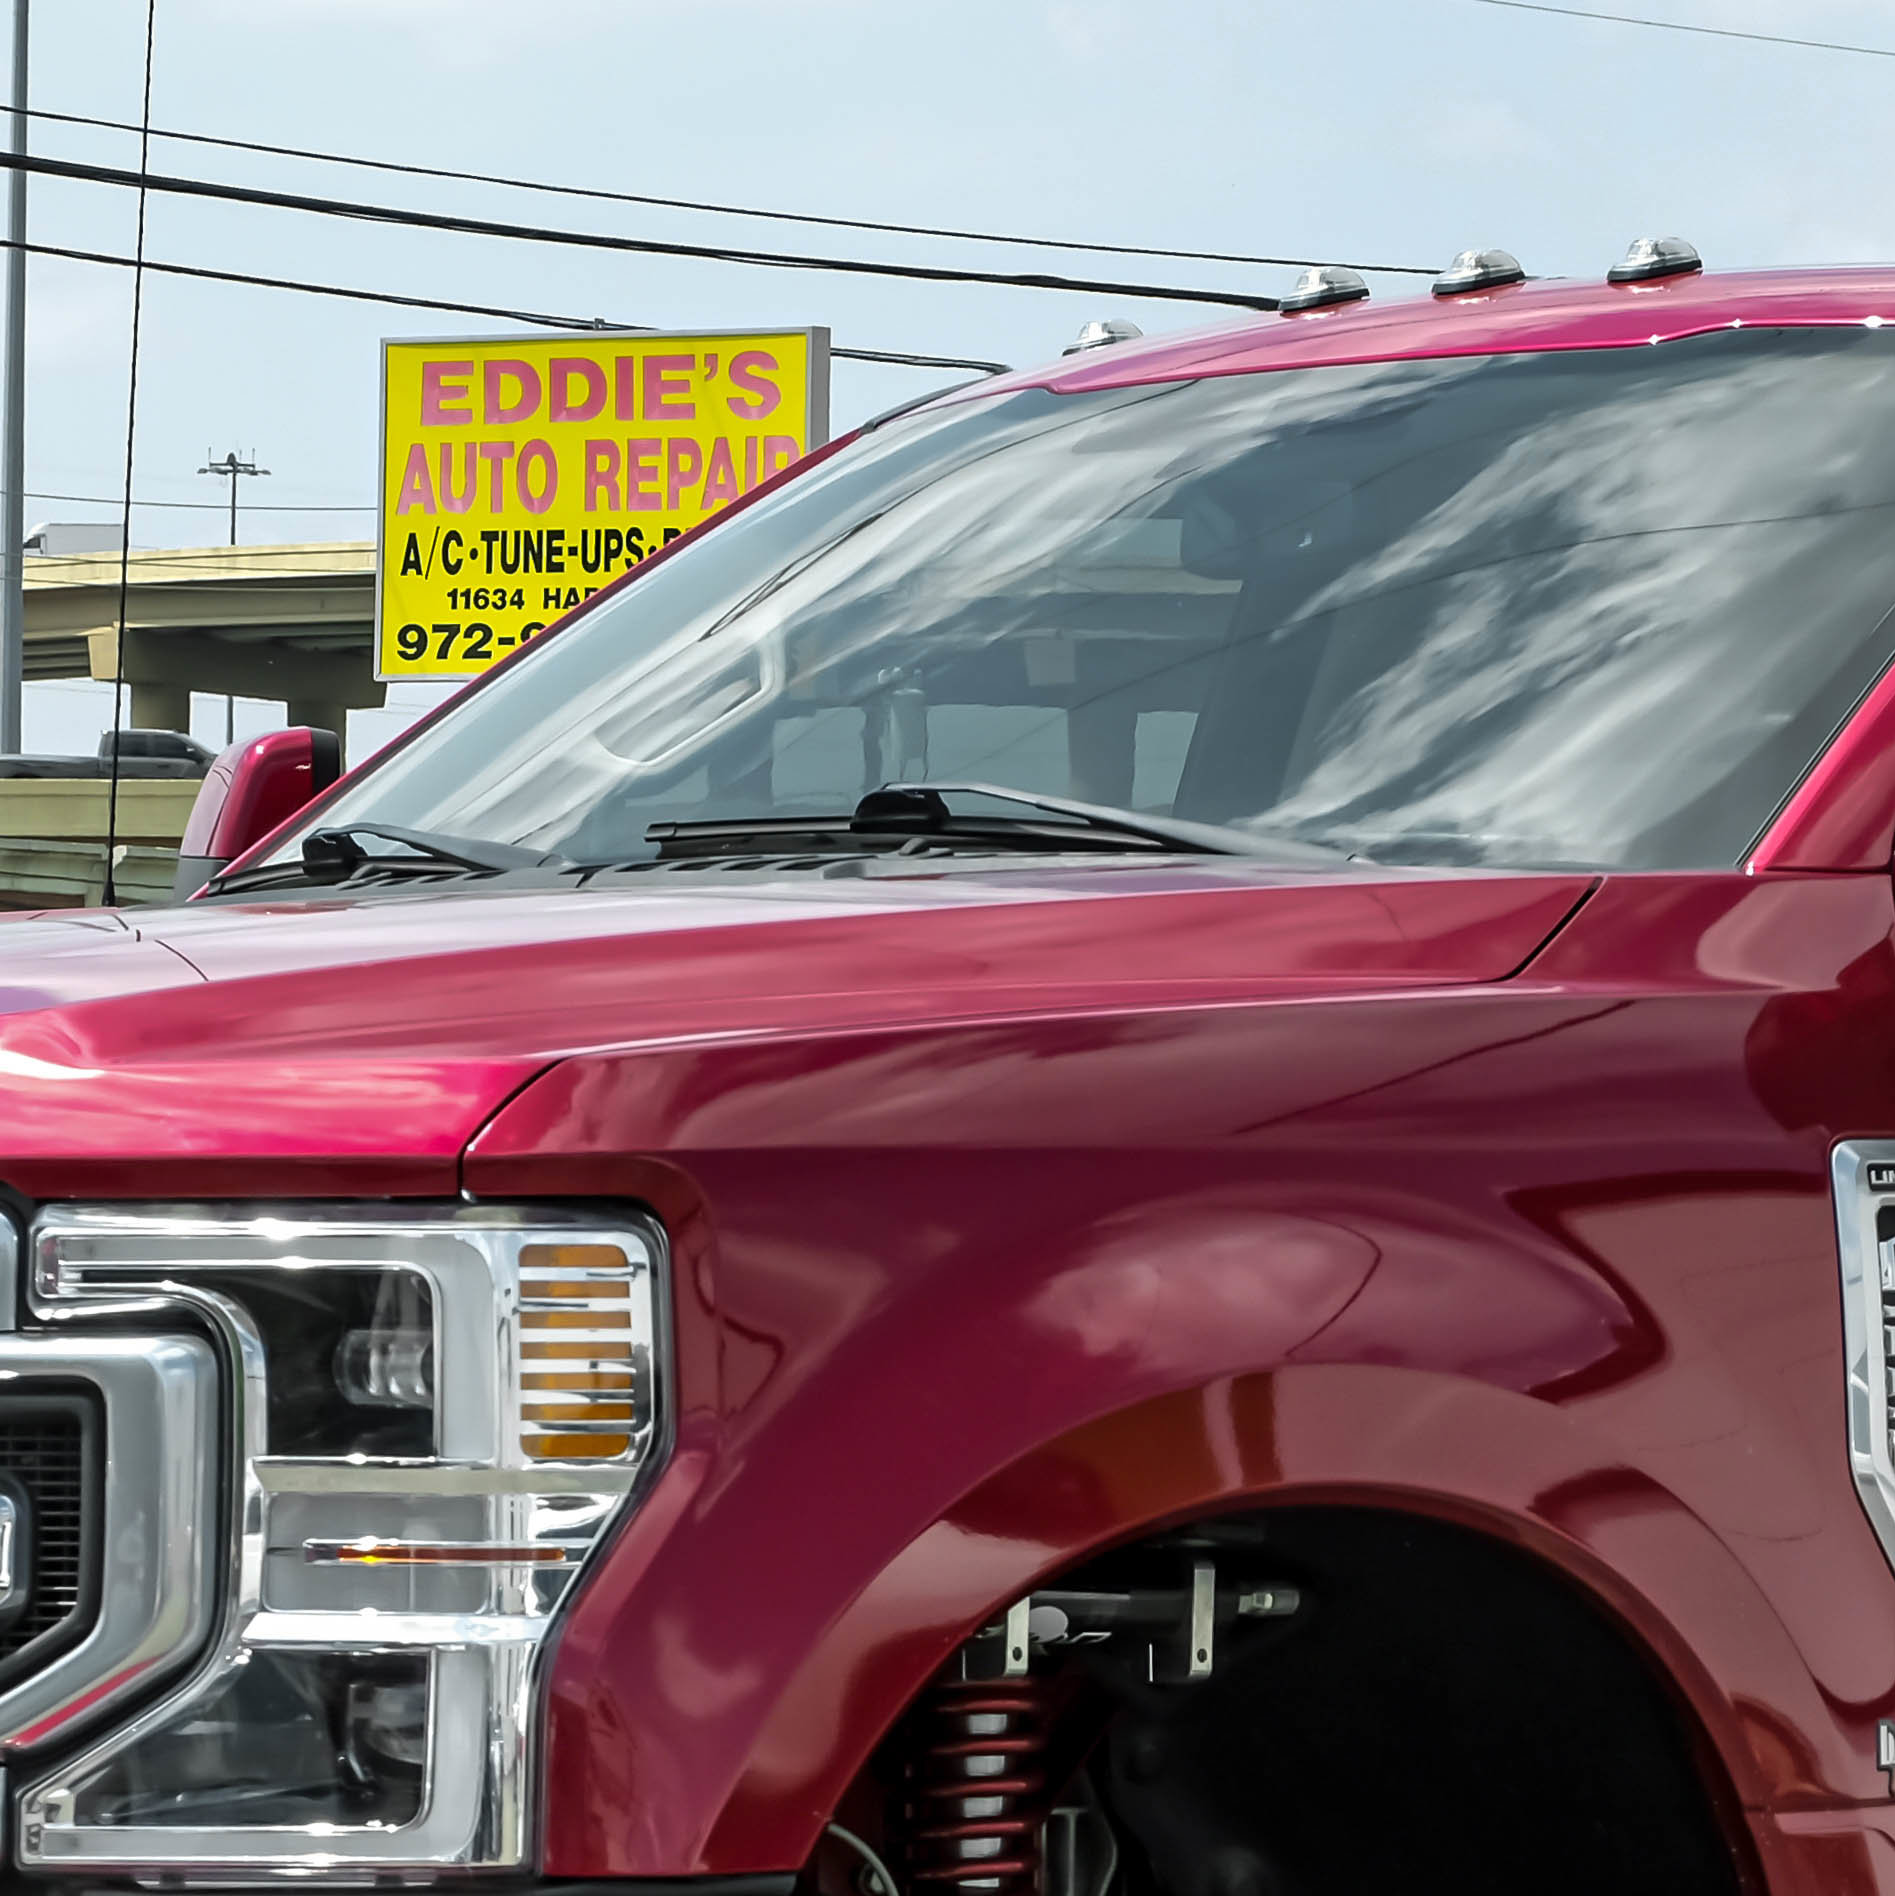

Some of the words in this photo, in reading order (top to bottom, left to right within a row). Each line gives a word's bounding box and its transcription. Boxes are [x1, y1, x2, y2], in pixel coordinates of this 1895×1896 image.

[420, 351, 782, 427] EDDIE'S
[397, 438, 558, 516] AUTO
[446, 587, 525, 610] 11634
